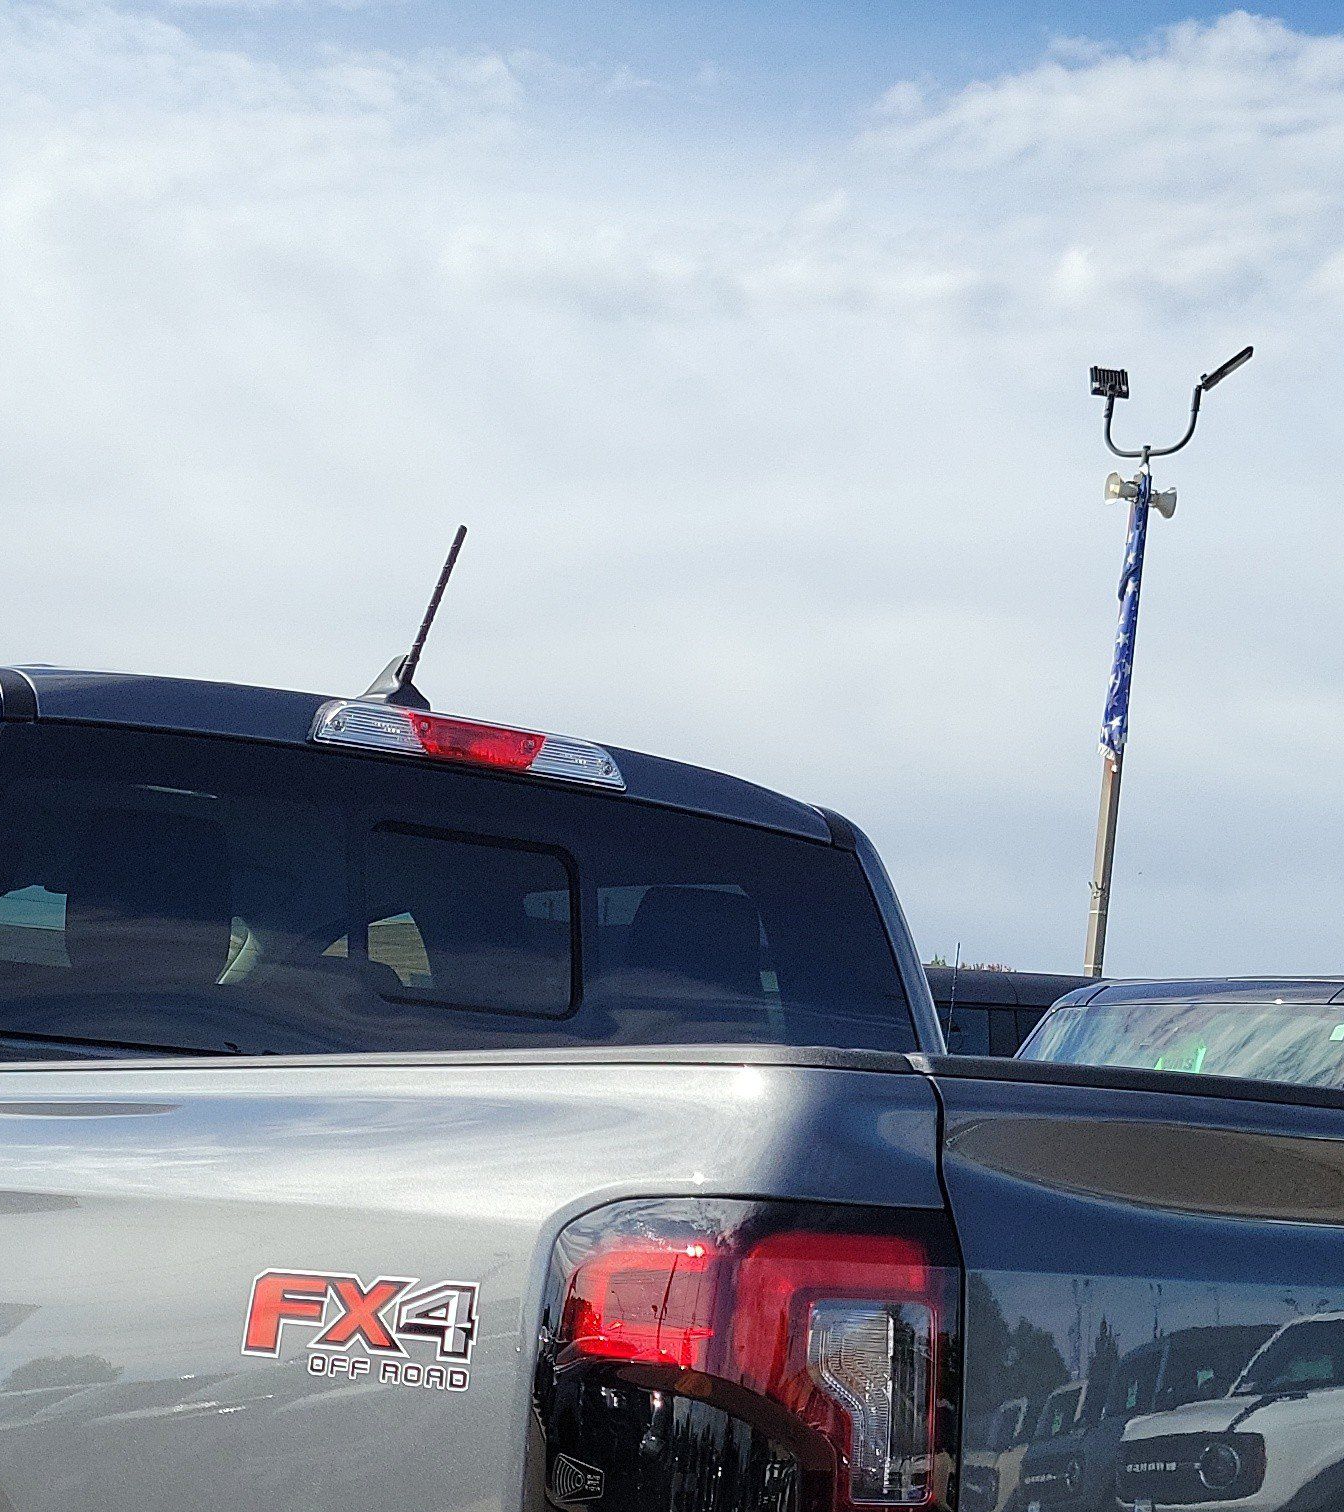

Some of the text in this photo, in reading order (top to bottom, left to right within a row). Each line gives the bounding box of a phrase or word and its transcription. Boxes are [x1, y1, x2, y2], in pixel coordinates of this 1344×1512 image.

[241, 1268, 480, 1364] FX4
[308, 1355, 470, 1392] OFF ROAD
